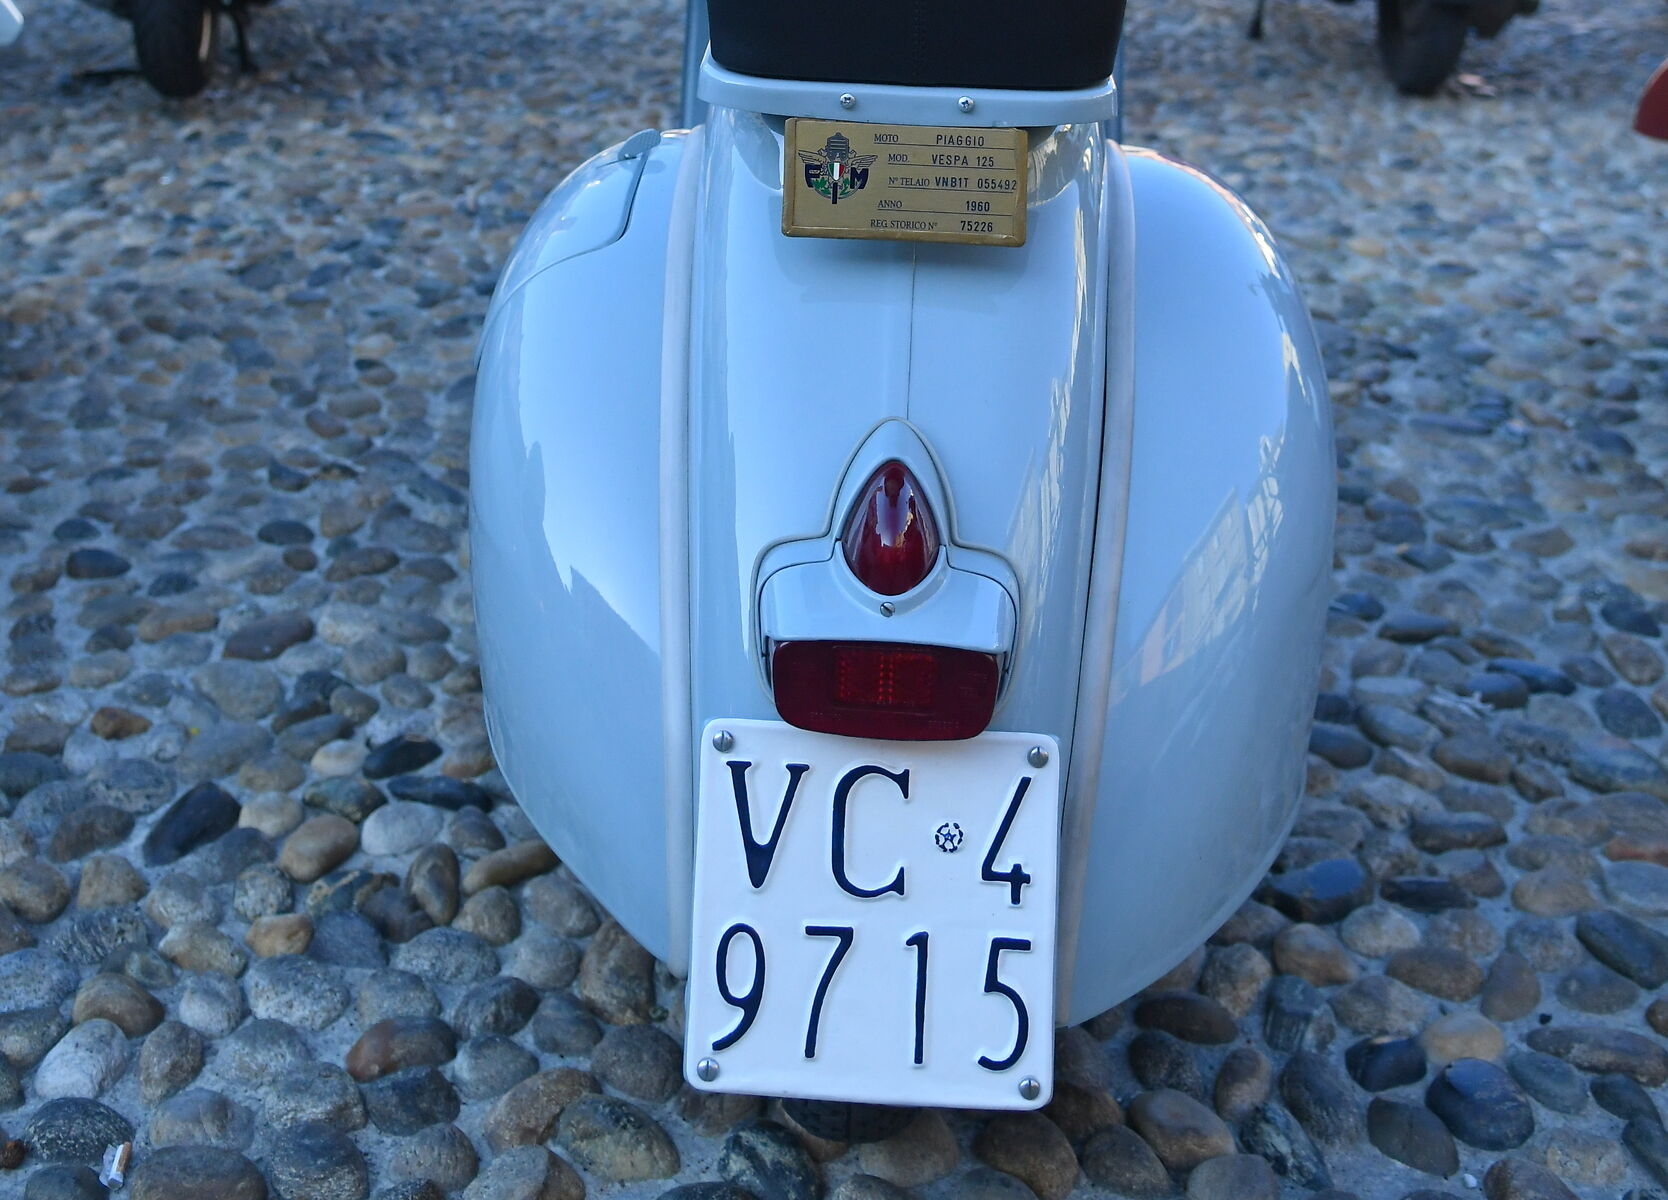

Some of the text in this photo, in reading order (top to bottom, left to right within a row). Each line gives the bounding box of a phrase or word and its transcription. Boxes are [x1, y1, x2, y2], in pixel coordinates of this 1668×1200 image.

[874, 133, 985, 147] MOTO PIAGGIO
[931, 154, 969, 166] VESPA
[976, 156, 994, 167] 125
[900, 177, 930, 187] TELAIO
[935, 176, 969, 188] VNB1T
[977, 178, 1017, 190] 055492
[878, 200, 990, 212] ANNO 1960
[890, 220, 927, 230] STORICO
[960, 220, 993, 232] 75226
[726, 760, 1032, 905] VC 4
[712, 922, 1032, 1071] 9715
